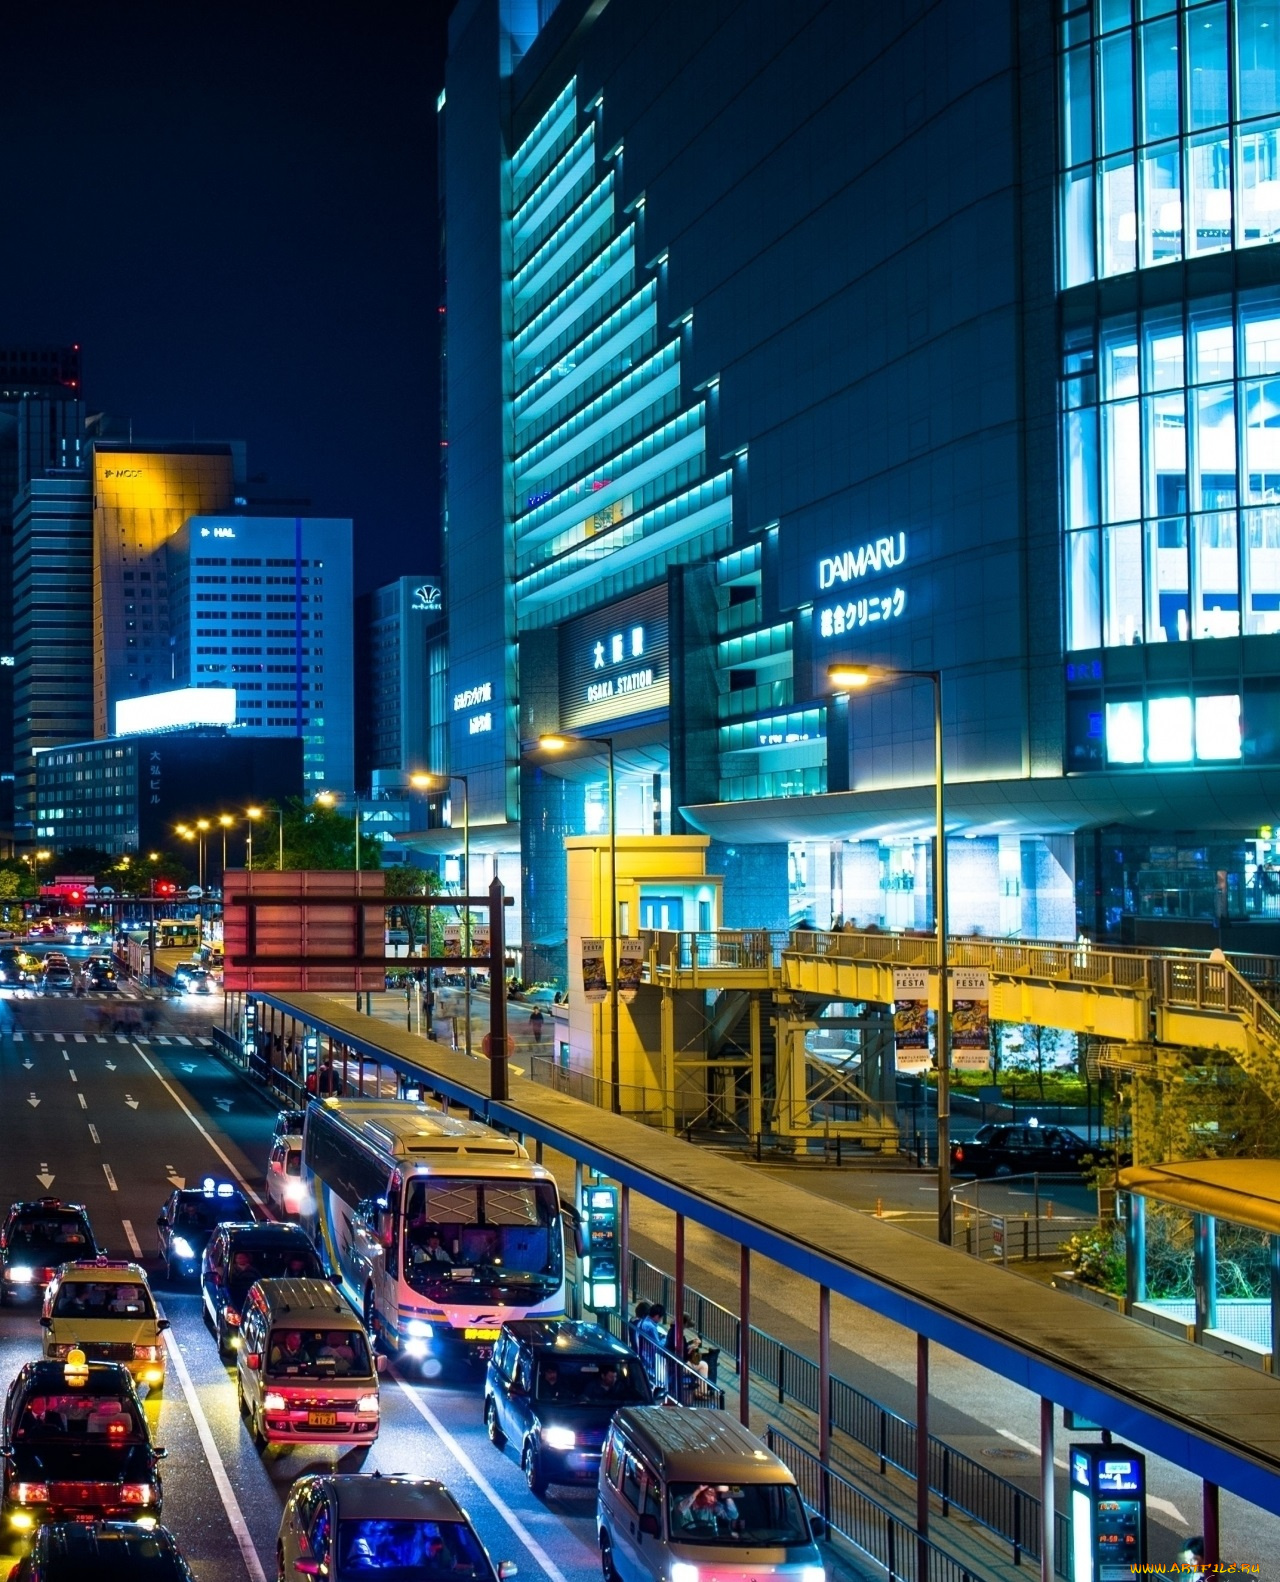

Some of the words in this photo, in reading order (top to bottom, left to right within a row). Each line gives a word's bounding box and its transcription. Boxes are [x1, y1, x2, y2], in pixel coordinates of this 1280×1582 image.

[213, 527, 236, 538] HAL
[820, 531, 906, 590] DAIMARU
[587, 680, 614, 702] OSAKA
[617, 668, 653, 694] STATION
